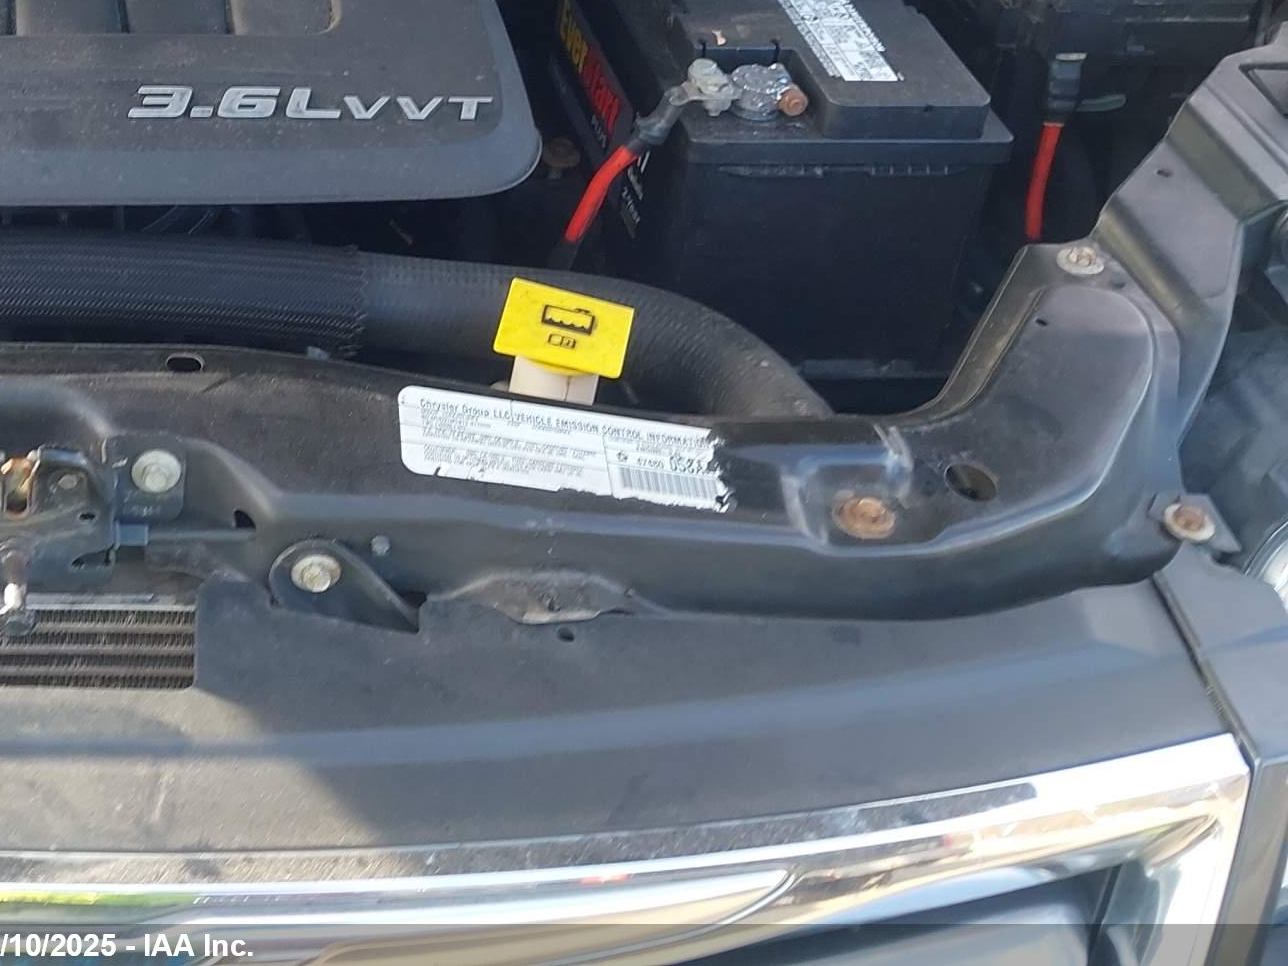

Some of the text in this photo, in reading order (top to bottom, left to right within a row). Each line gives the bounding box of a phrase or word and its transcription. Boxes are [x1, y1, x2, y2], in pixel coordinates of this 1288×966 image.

[419, 398, 459, 414] Chrysler
[461, 403, 490, 418] Group
[493, 409, 511, 421] LLC
[514, 412, 552, 427] VEHICLE
[555, 417, 600, 434] EMISSION
[601, 425, 641, 441] CONTROL
